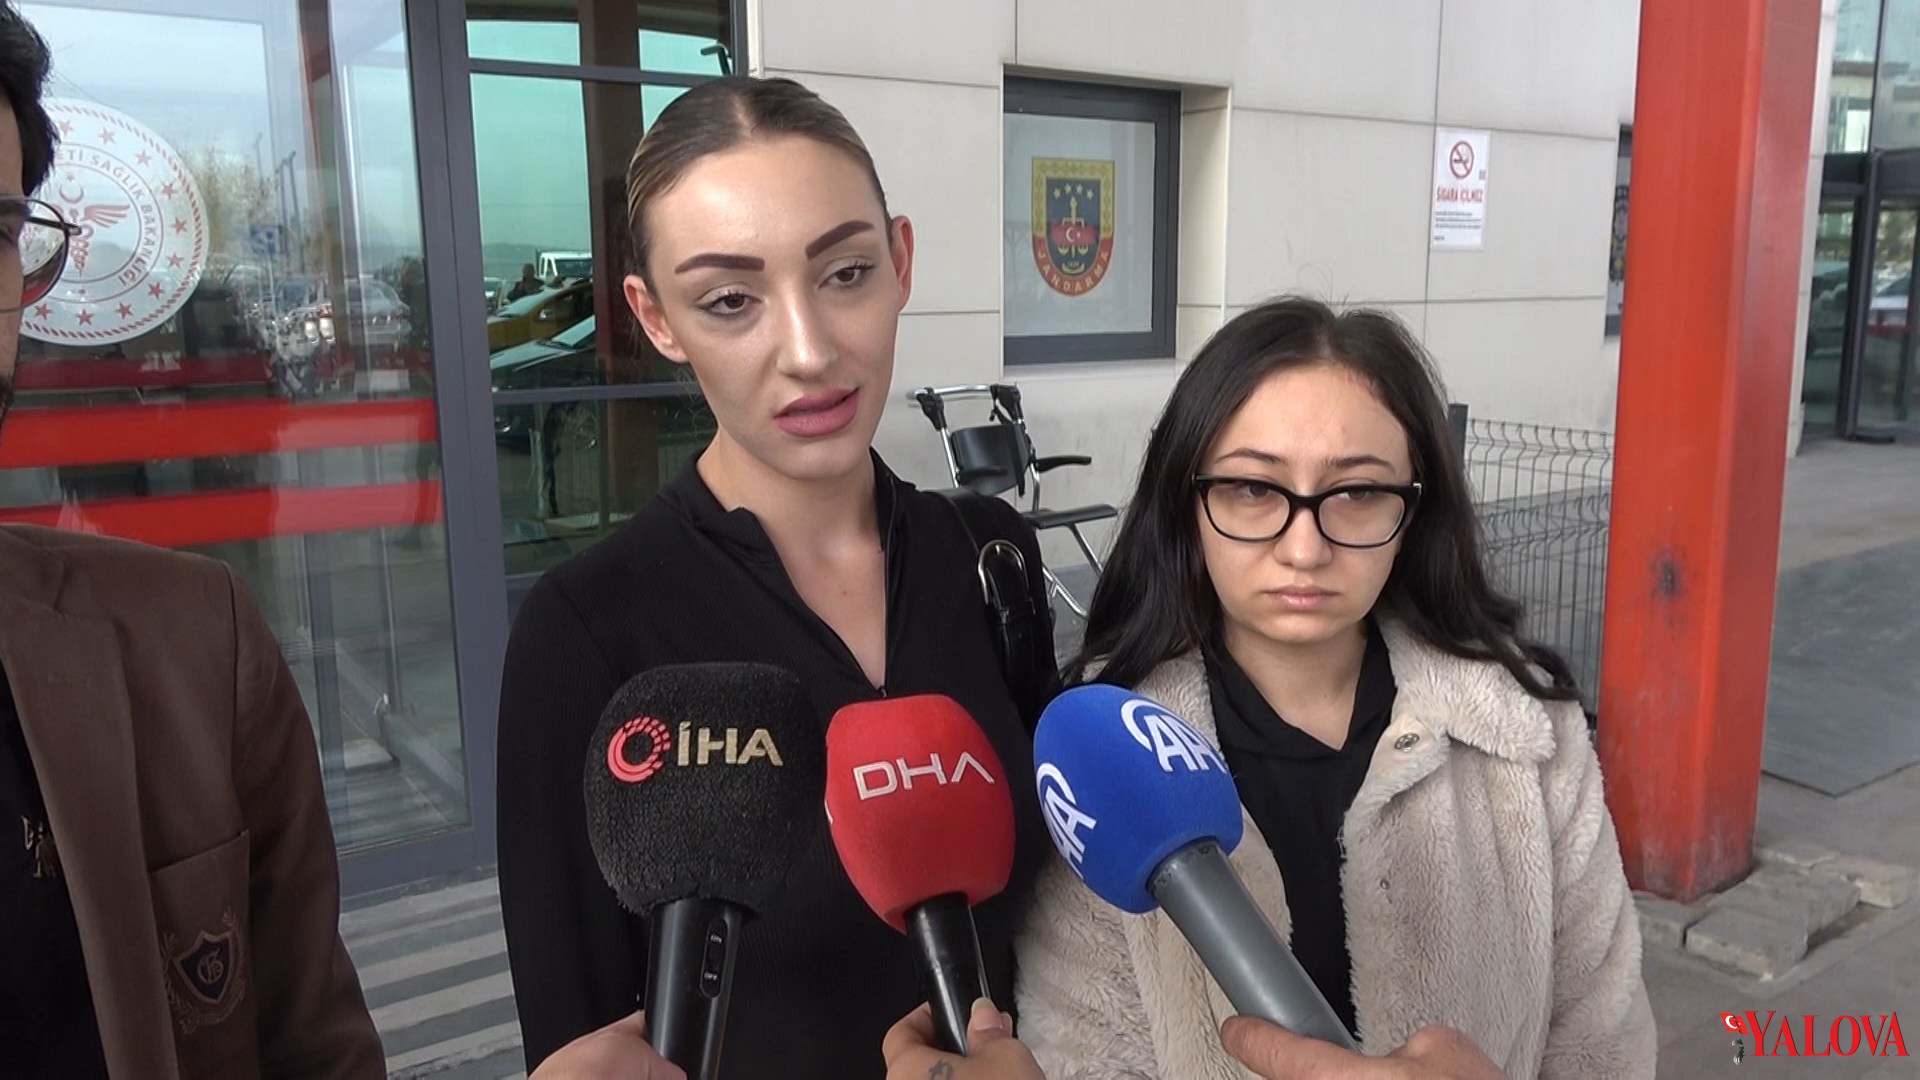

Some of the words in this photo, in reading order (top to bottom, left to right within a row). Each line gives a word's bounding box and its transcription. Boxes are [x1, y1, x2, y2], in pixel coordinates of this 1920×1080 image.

[1037, 251, 1109, 290] JANDARMA
[677, 720, 784, 766] İHA
[1143, 714, 1227, 774] AA
[853, 750, 996, 800] DHA
